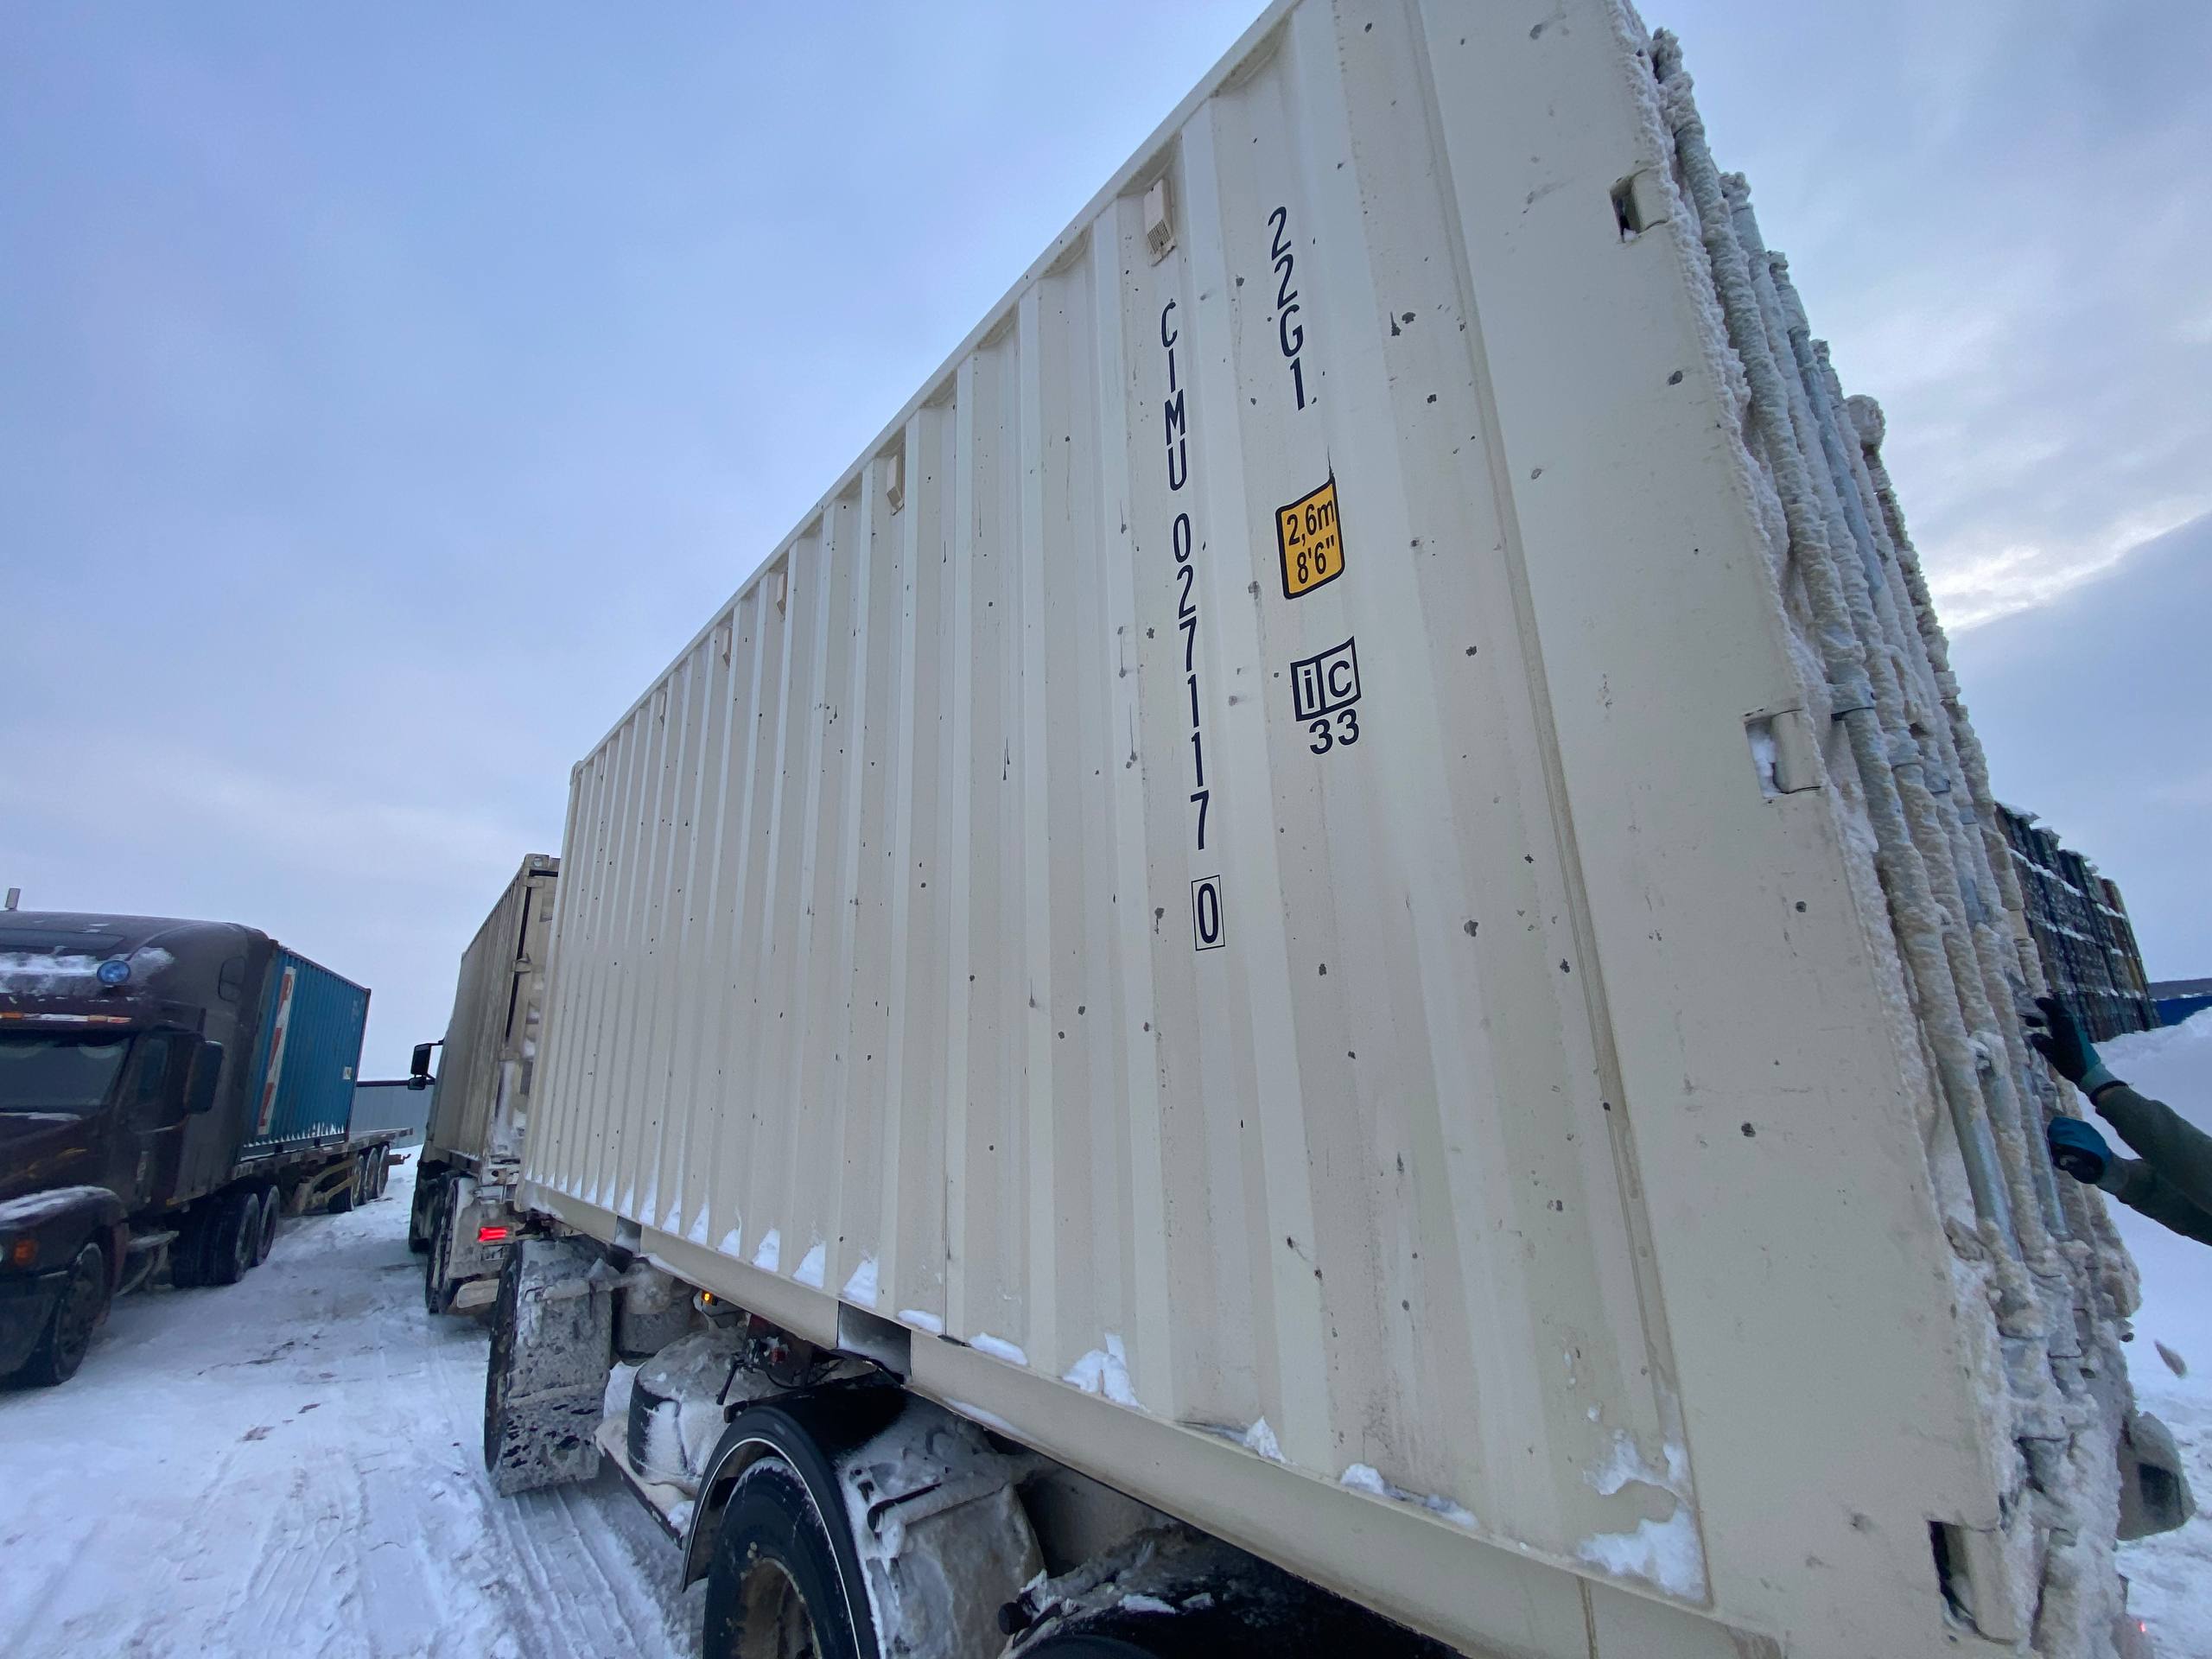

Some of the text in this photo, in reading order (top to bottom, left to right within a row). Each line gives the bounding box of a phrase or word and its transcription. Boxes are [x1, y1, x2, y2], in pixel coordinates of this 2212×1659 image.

[1268, 206, 1305, 410] 22G1
[1286, 499, 1335, 545] 2,6m
[1161, 302, 1219, 944] CIMU 027117 0
[1309, 709, 1359, 755] 33
